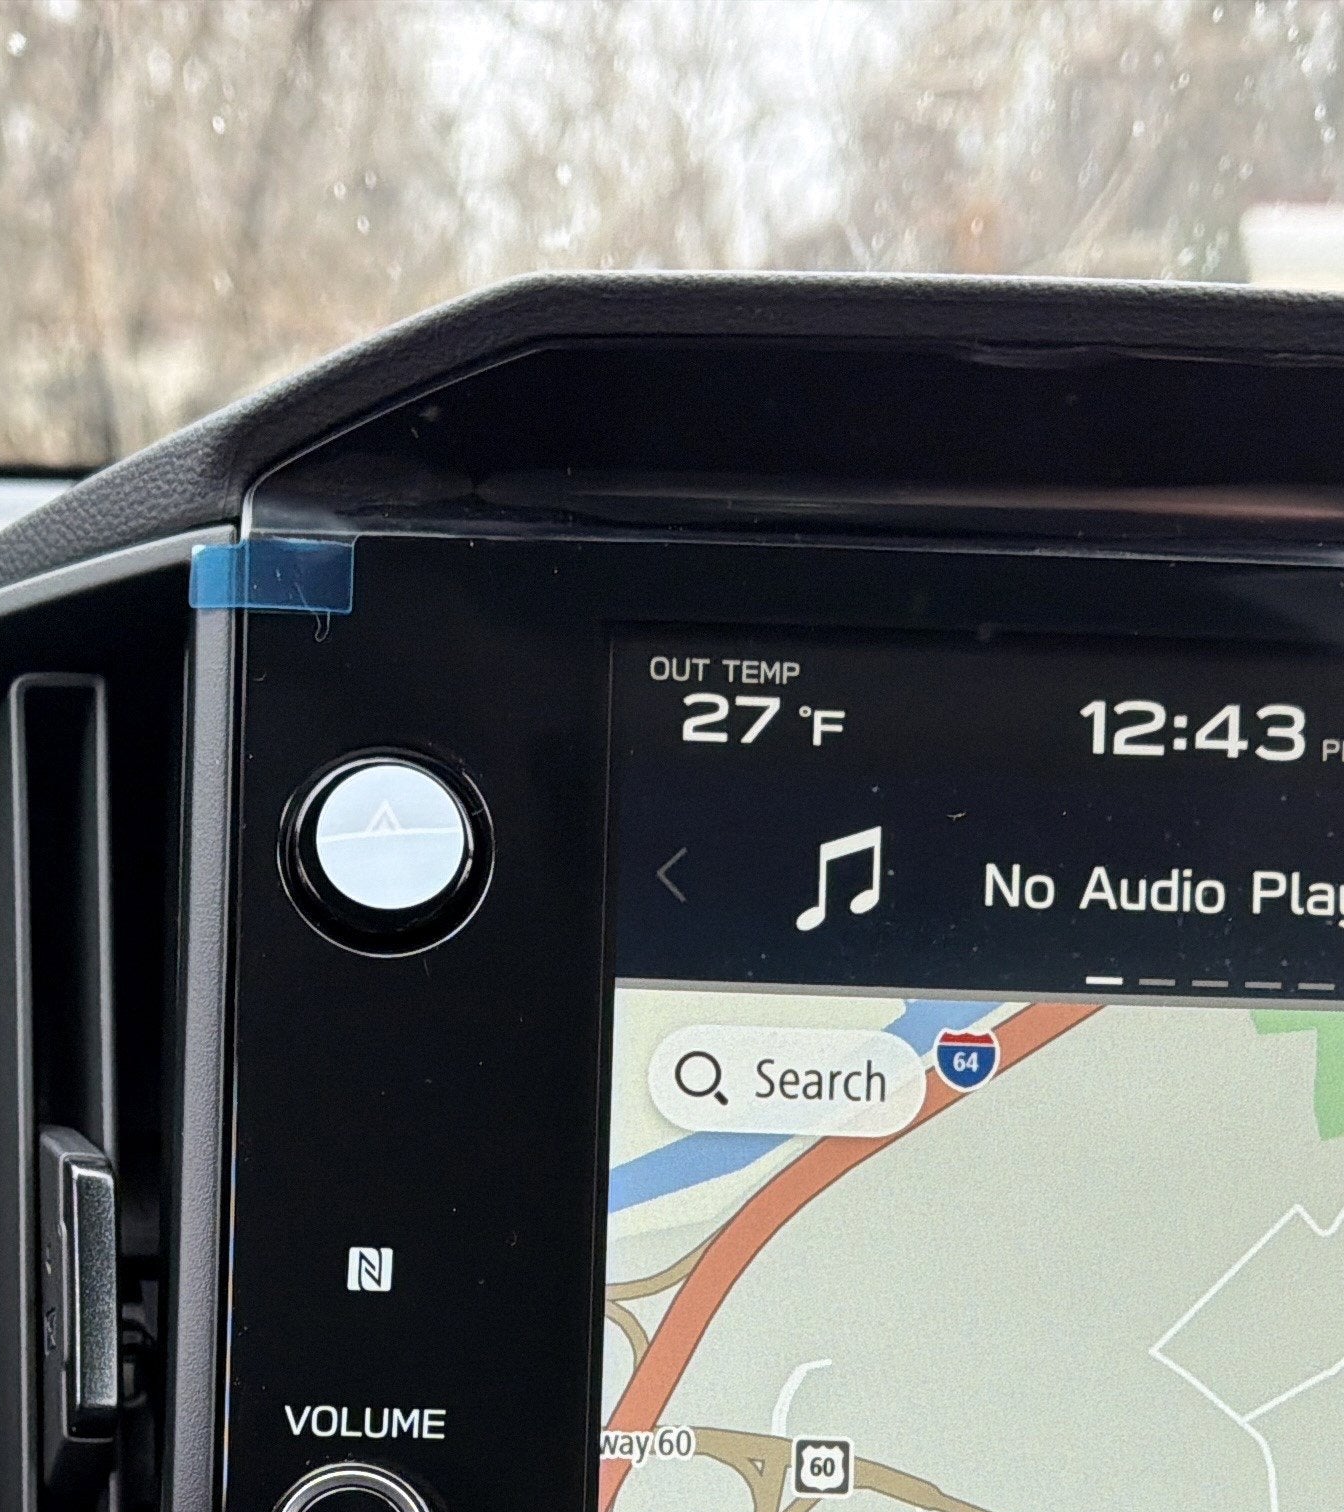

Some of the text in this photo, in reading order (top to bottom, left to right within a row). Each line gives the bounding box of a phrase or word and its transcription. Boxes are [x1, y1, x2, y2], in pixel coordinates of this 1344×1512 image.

[649, 656, 800, 685] OUT TEMP
[682, 692, 780, 744] 27
[1079, 700, 1306, 762] 12:43
[984, 863, 1055, 909] No
[1079, 866, 1226, 915] Audio
[952, 1051, 979, 1074] 64
[755, 1058, 887, 1103] Search
[284, 1405, 447, 1439] VOLUME
[658, 1429, 692, 1456] 60
[810, 1457, 836, 1478] 60
